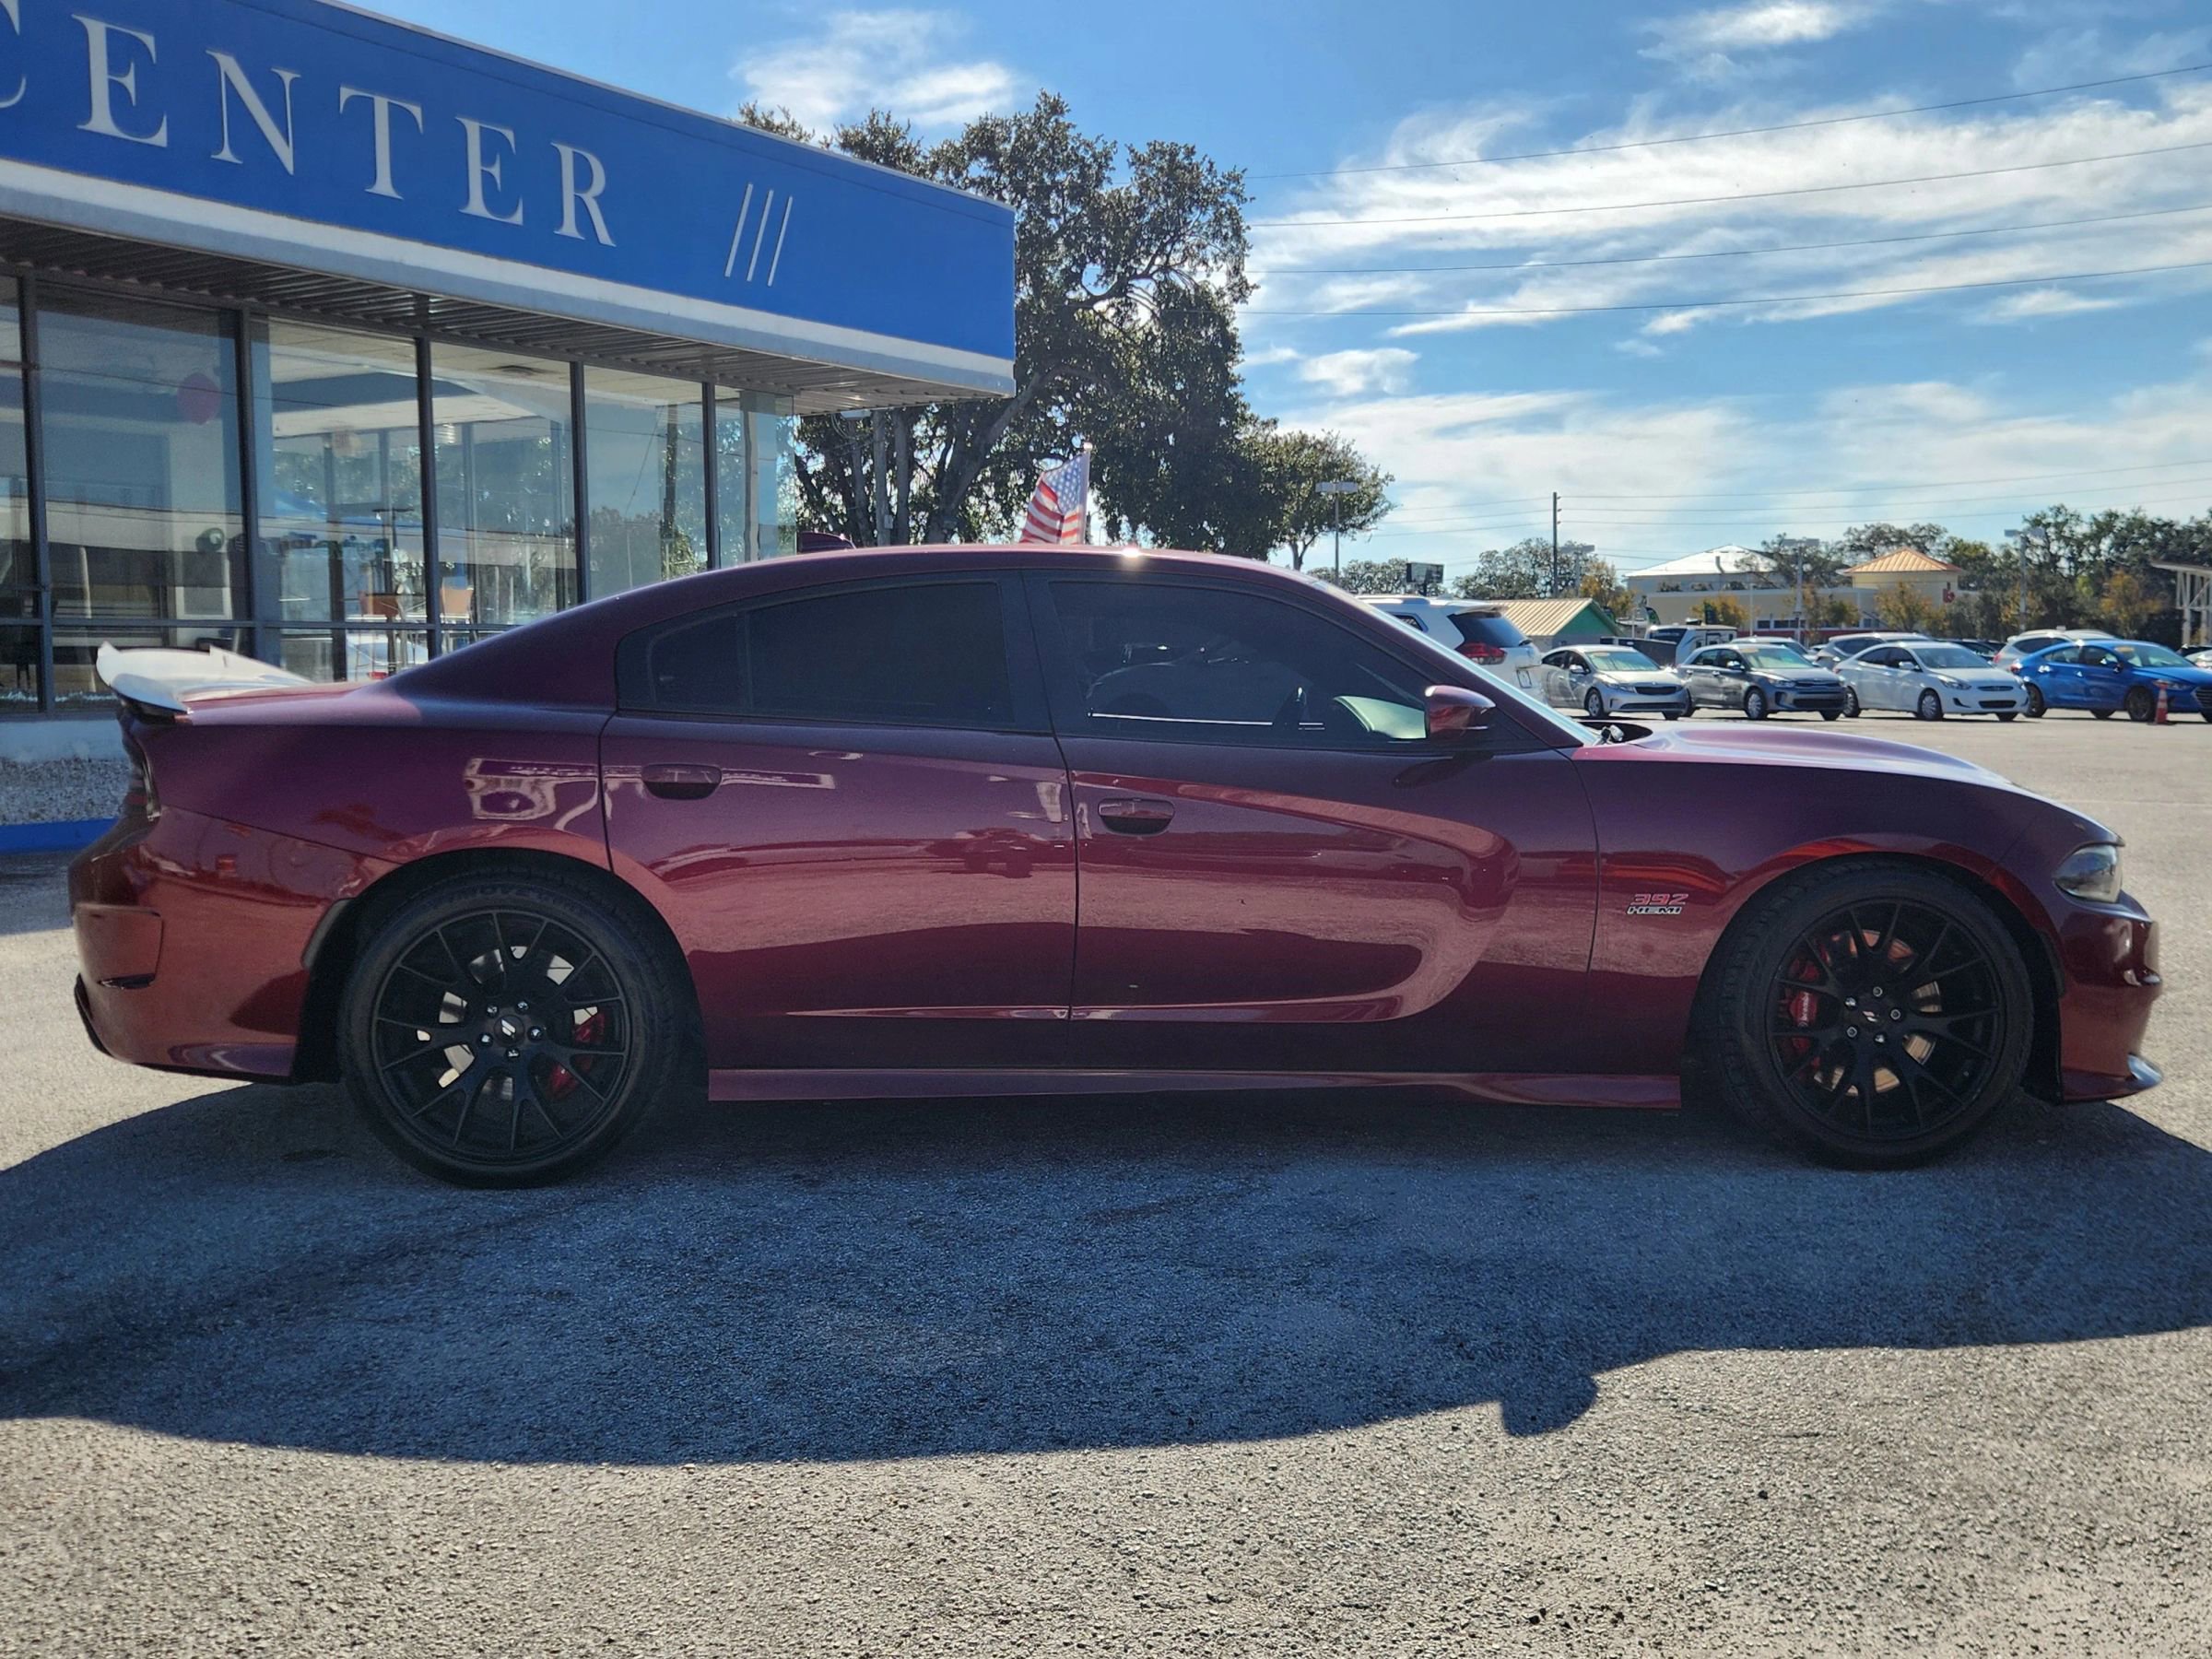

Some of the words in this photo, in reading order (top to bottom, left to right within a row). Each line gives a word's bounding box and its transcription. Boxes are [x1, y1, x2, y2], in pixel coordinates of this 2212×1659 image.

[0, 0, 617, 247] ENTER
[1630, 893, 1688, 905] 392
[1627, 906, 1682, 914] HEMI
